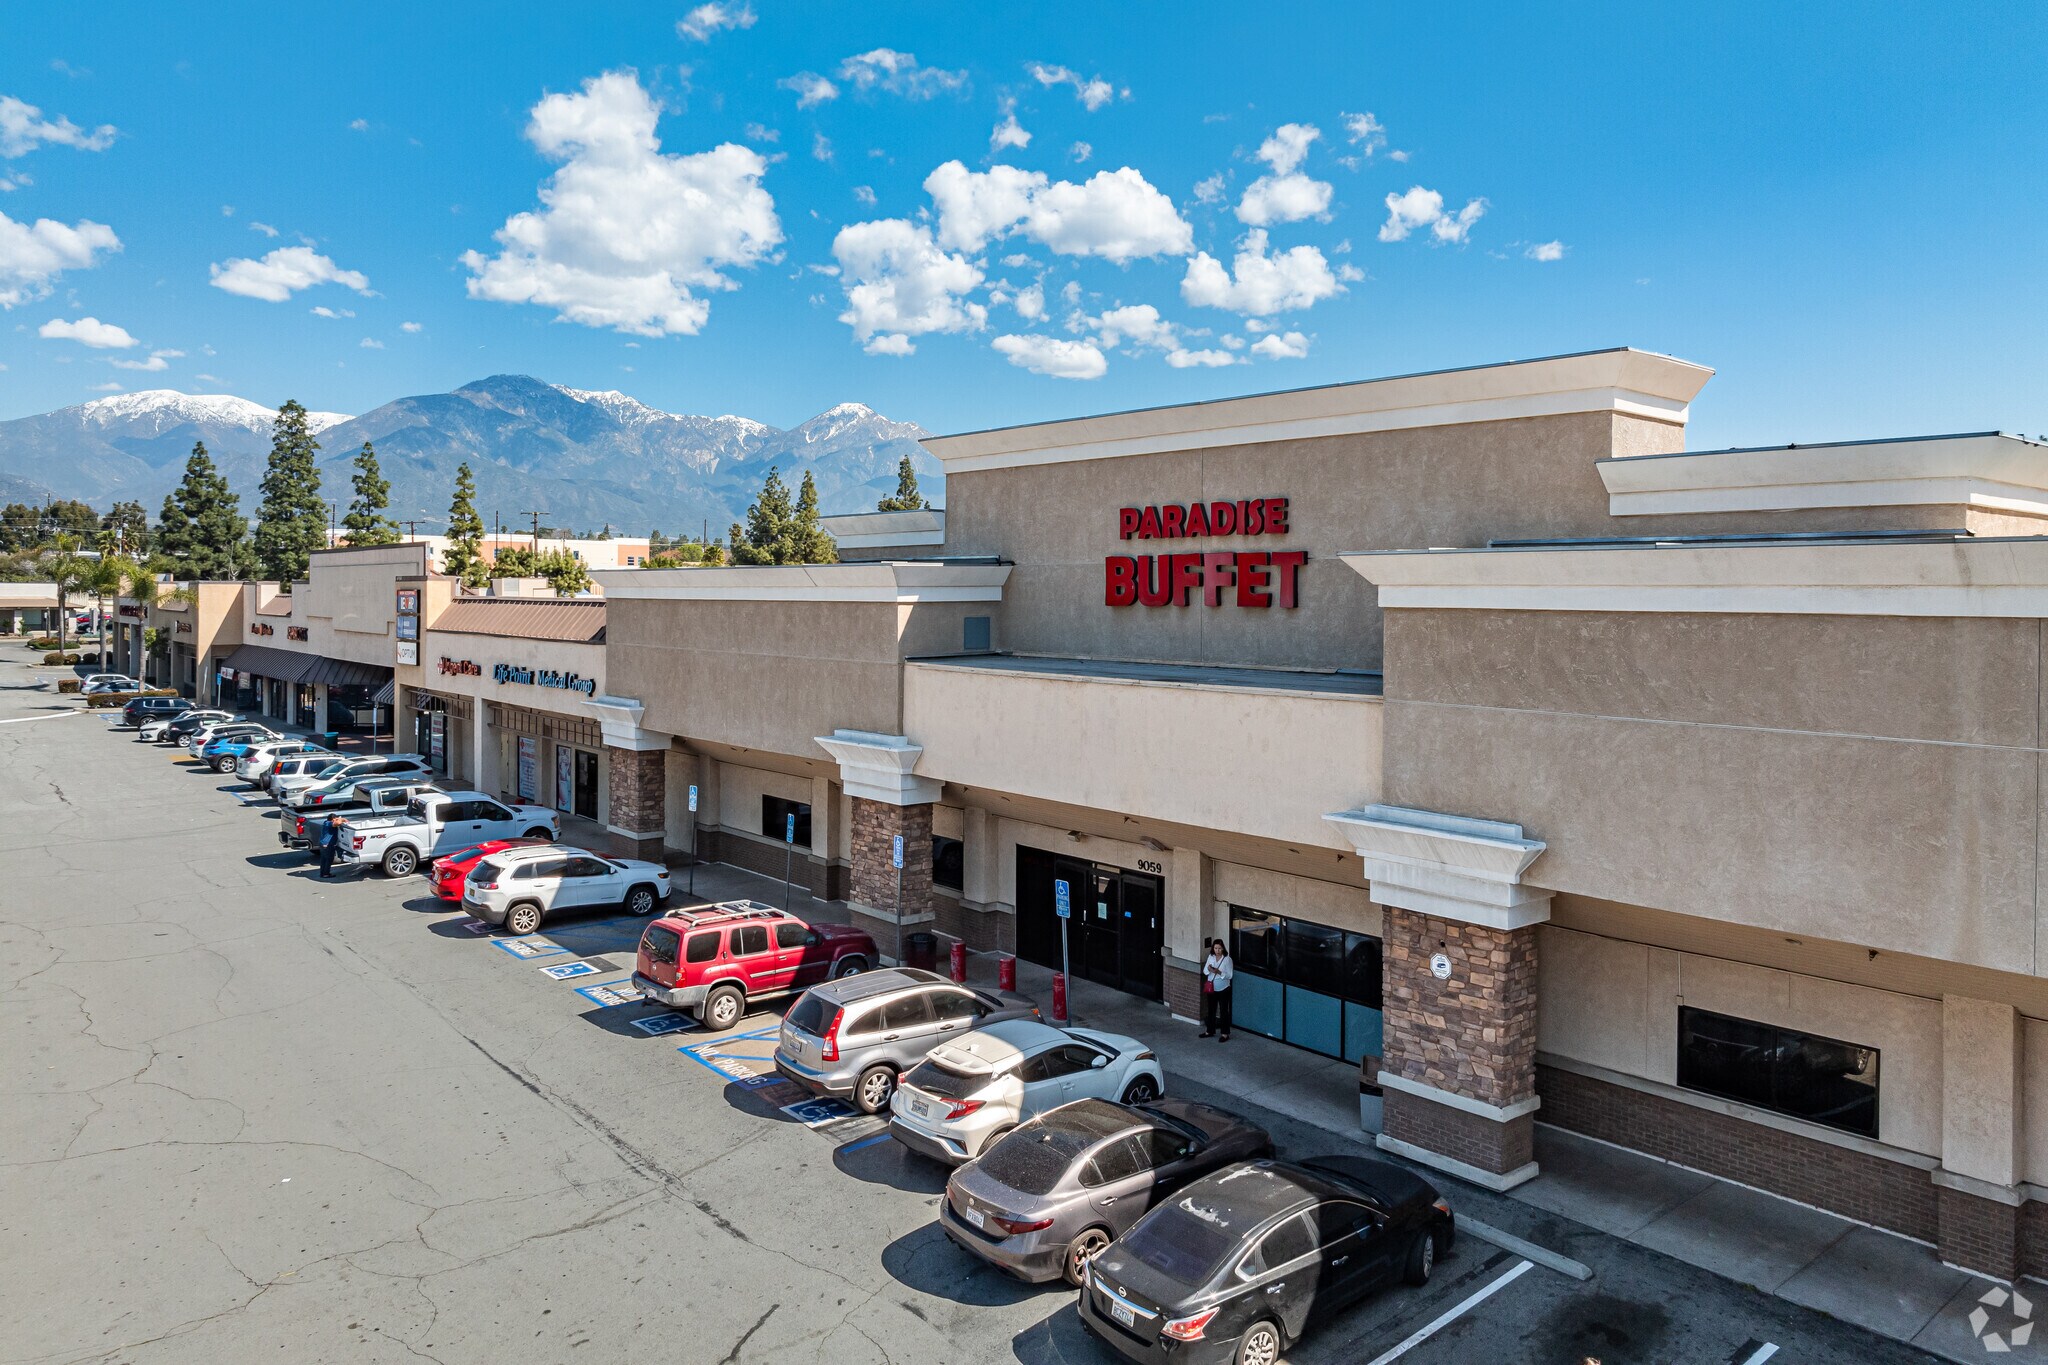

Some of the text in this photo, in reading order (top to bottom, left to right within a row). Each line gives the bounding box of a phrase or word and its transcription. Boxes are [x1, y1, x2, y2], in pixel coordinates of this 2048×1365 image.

[1119, 497, 1289, 540] PARADISE
[1105, 551, 1308, 608] BUFFET
[441, 656, 482, 676] Urgent Care
[492, 664, 596, 697] Life Point Medical Group
[1137, 859, 1162, 874] 9059
[694, 1043, 720, 1057] NO
[714, 1058, 768, 1085] PARKING
